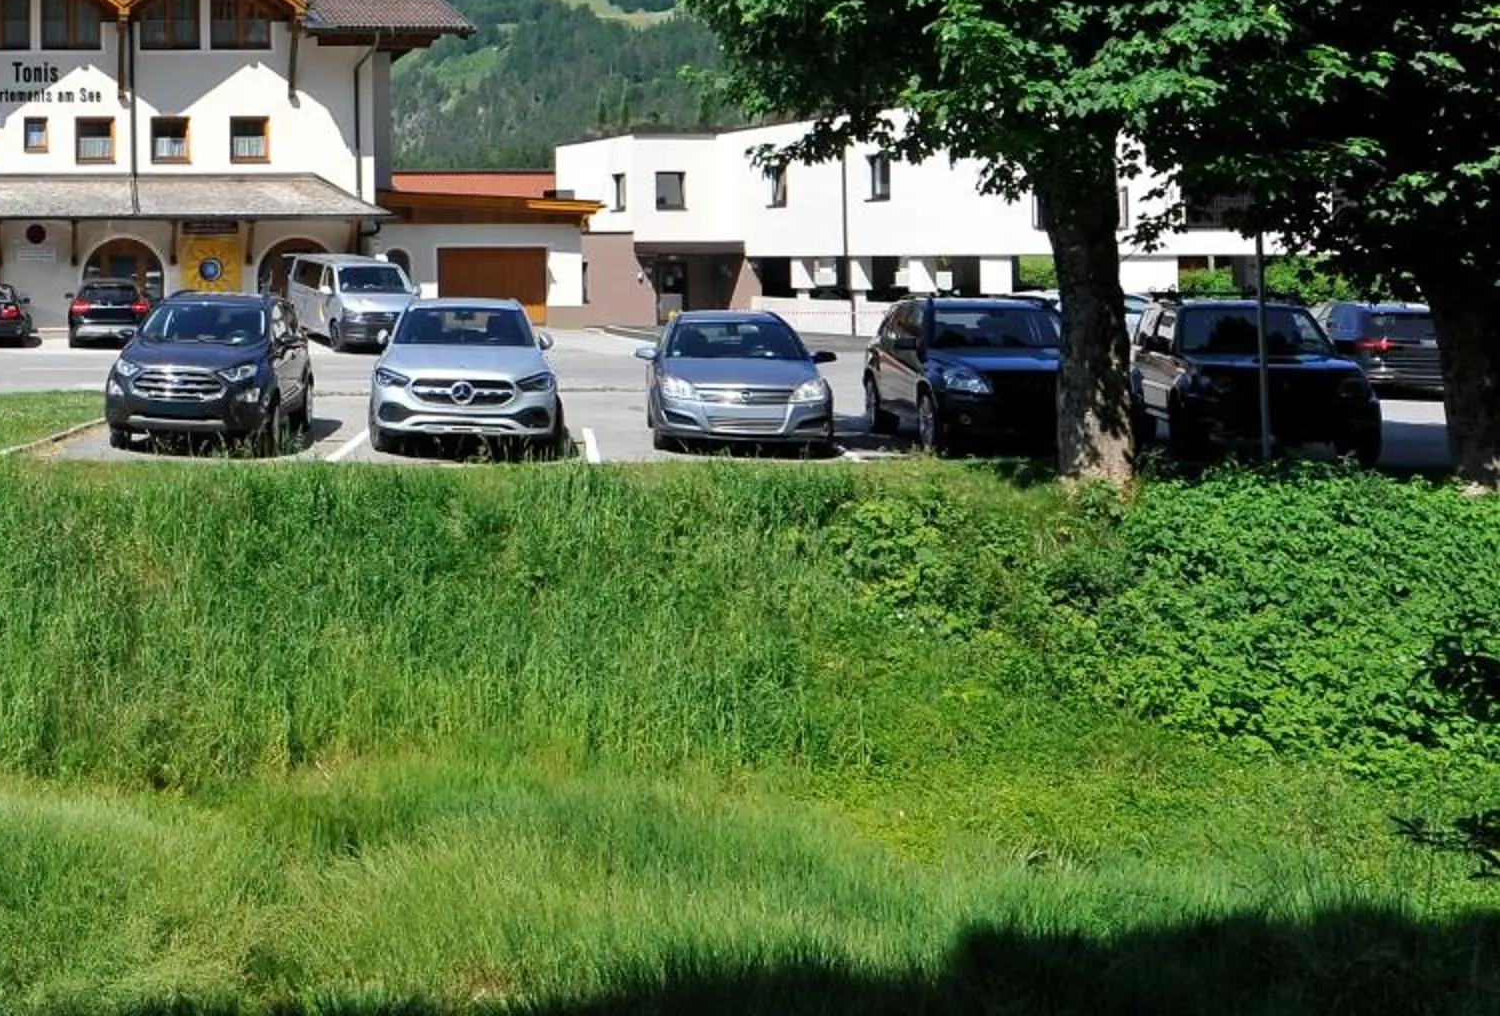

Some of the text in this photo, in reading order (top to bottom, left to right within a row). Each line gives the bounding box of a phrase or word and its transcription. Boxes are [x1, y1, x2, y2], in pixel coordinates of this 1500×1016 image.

[12, 62, 59, 83] Tonis
[58, 90, 75, 103] am
[80, 88, 102, 103] See
